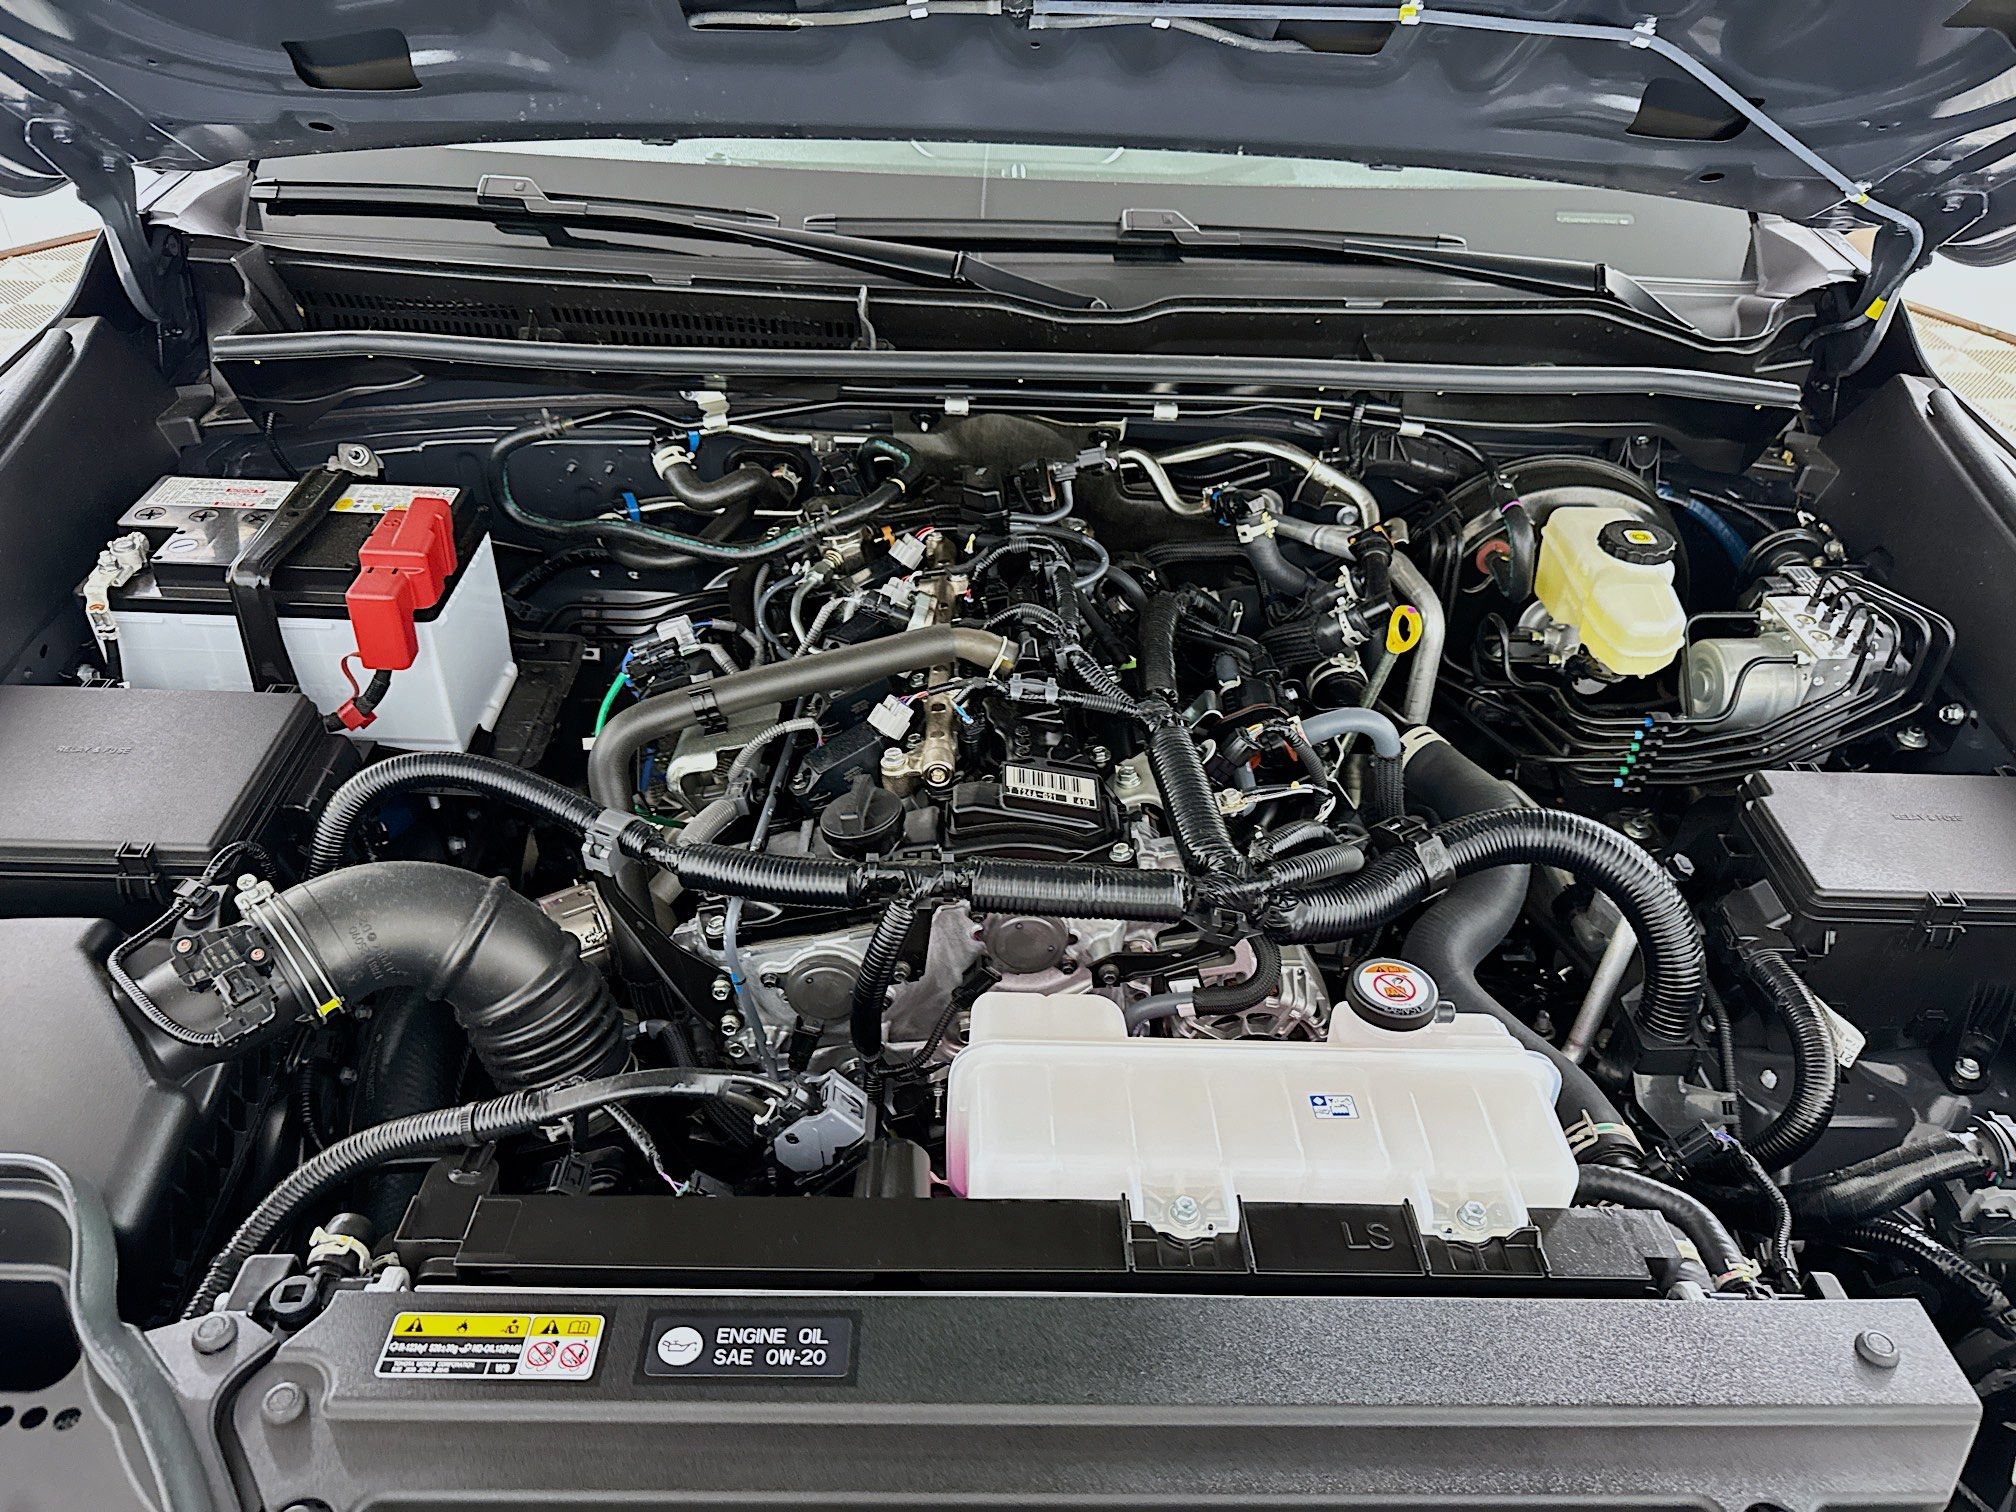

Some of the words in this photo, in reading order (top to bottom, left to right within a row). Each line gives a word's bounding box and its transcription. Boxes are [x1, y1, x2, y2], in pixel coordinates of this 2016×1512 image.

[1341, 1221, 1395, 1250] LS
[716, 1327, 788, 1345] ENGINE
[798, 1328, 829, 1345] OIL
[713, 1348, 754, 1366] SAE
[765, 1348, 827, 1366] 0W-20
